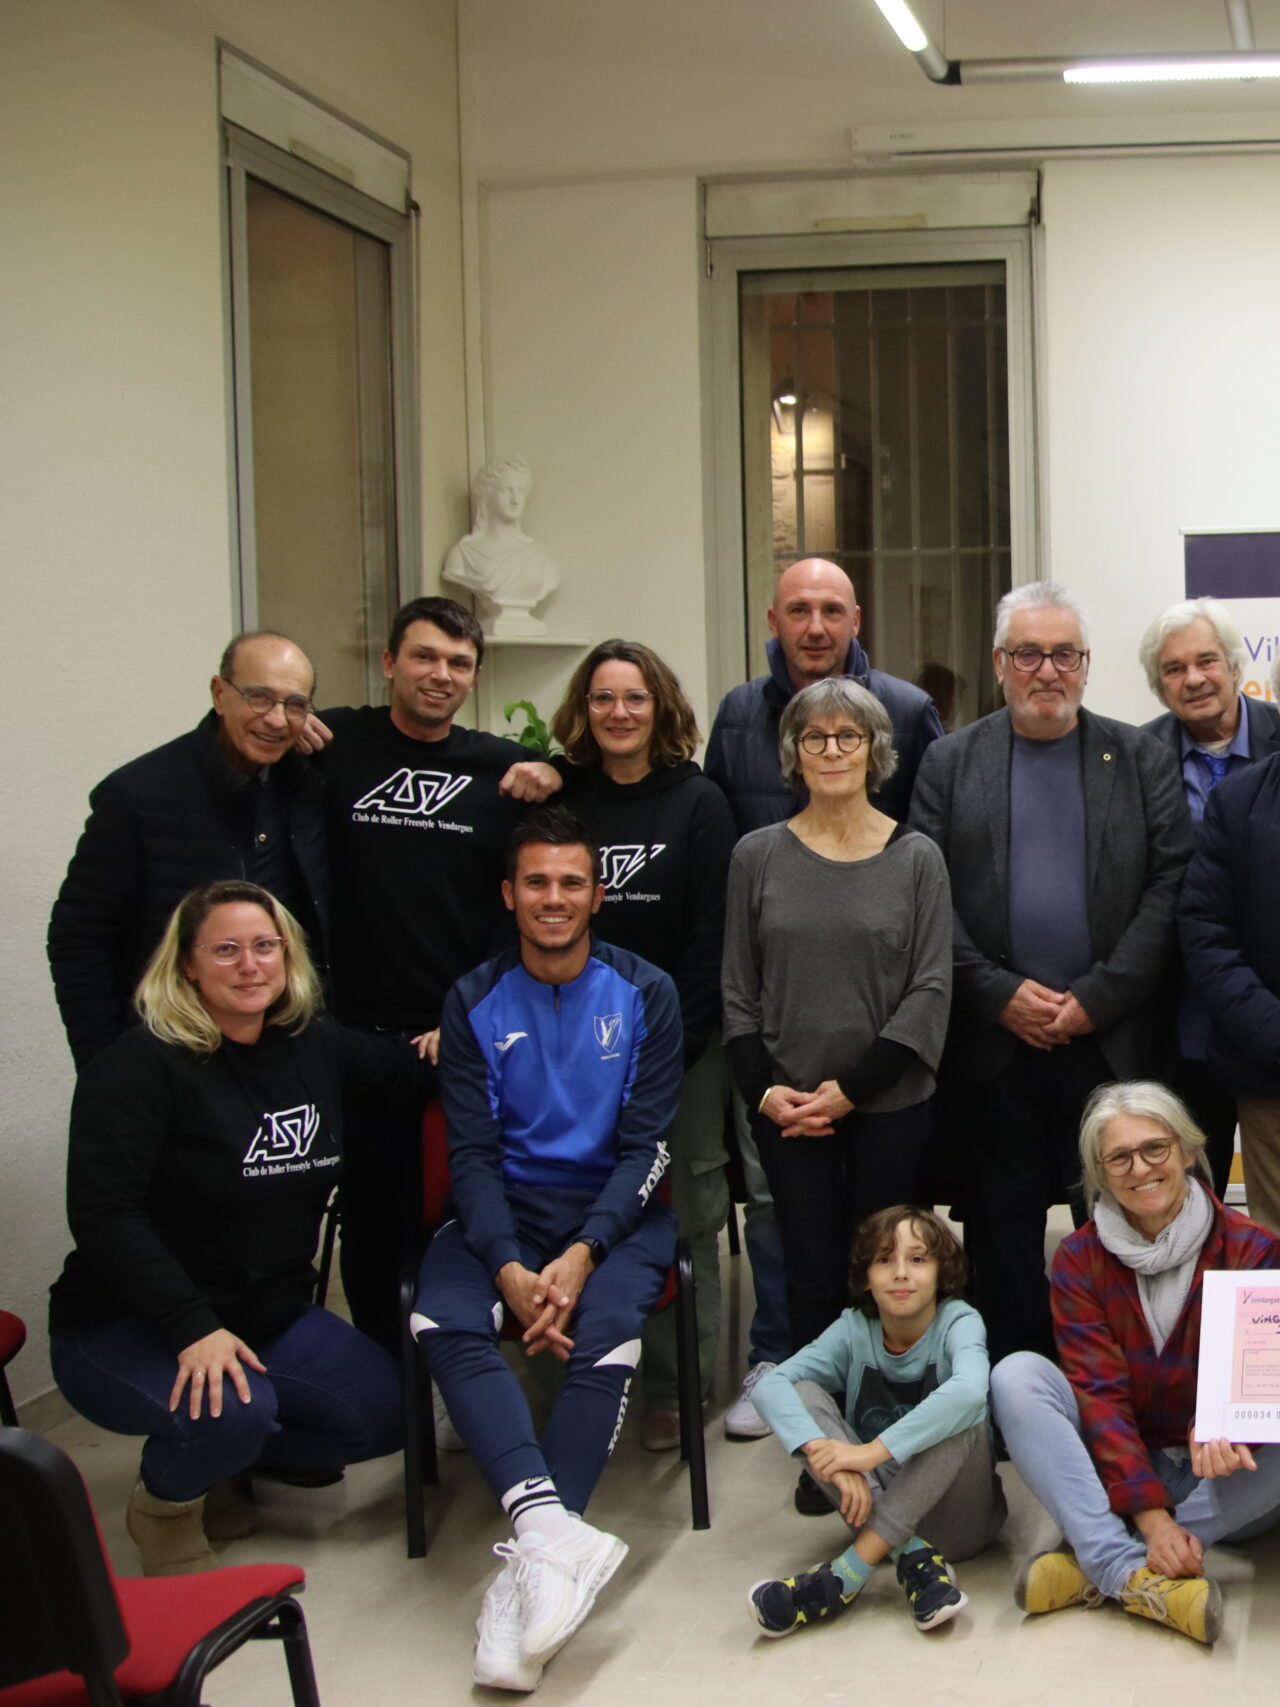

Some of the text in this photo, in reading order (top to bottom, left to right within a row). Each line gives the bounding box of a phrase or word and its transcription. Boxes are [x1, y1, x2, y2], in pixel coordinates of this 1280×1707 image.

[352, 767, 473, 815] ASV
[351, 812, 474, 834] Club de Roller Freestyle Vendargues
[599, 844, 667, 890] SV
[626, 891, 661, 903] Vendargues
[243, 1167, 259, 1177] Club
[260, 1166, 268, 1176] de
